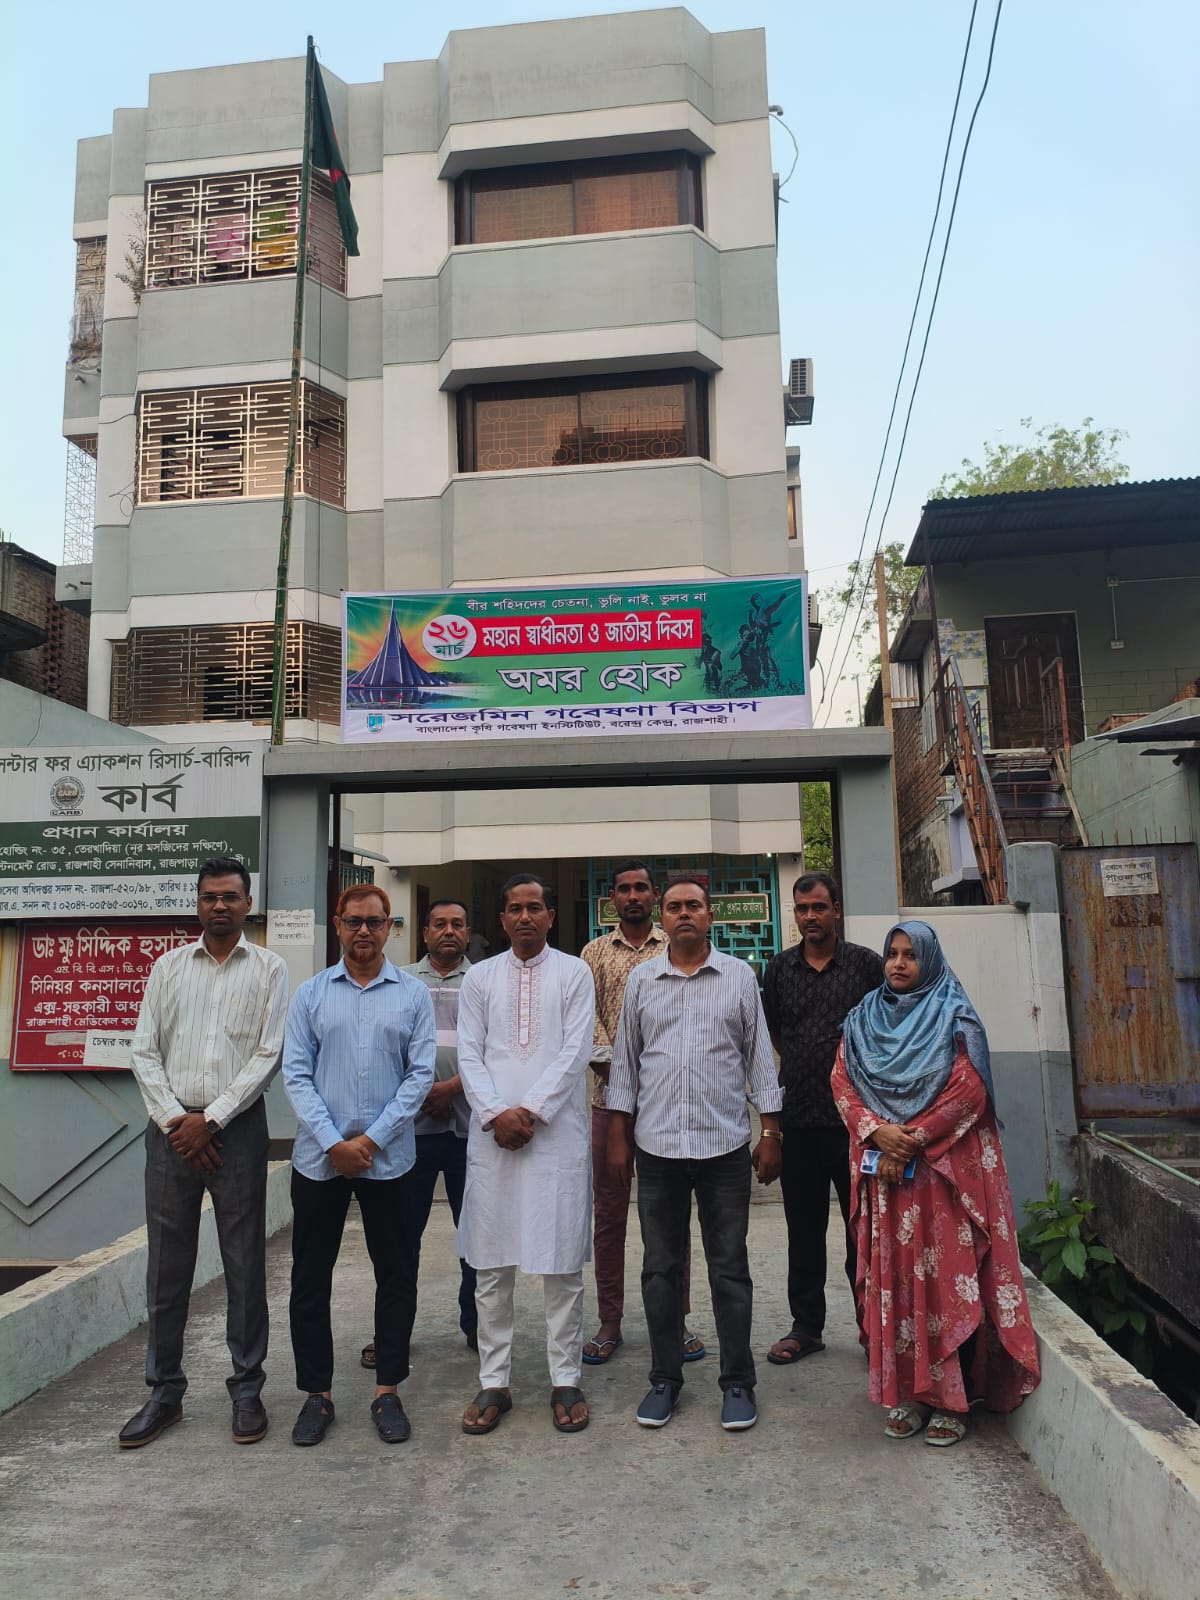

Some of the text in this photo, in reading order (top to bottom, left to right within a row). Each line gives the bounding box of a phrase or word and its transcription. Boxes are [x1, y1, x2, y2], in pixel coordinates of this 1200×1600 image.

[466, 592, 707, 611] বীর শহিদদের চেতনা, ভুলি নাই, ভুলব না
[428, 621, 468, 642] ২৬
[482, 612, 693, 648] মহান স্বাধীনতা ও জাতীয় দিবস
[433, 641, 465, 656] মার্চ
[496, 660, 686, 693] অমর হোক
[390, 701, 763, 724] সরেজমিন গবেষণা বিভাগ
[416, 726, 467, 734] বাংলাদেশ
[472, 723, 493, 734] কৃষি
[497, 723, 537, 732] গবেষণা
[542, 721, 605, 729] ইনস্টিটিউট,
[647, 719, 677, 727] কেন্দ্র,
[44, 756, 72, 772] ফর
[77, 752, 143, 771] এ্যাকশন
[148, 746, 252, 769] রিসার্চ-বারিন্দ
[97, 773, 185, 813] কার্ব
[43, 821, 189, 839] প্রধান কার্যালয়
[31, 847, 47, 855] নং-
[125, 843, 143, 856] (নূর
[146, 840, 188, 853] মসজিদের
[65, 857, 101, 870] রাজশাহী
[55, 885, 72, 894] সনদ
[158, 880, 181, 892] তারিখ
[23, 902, 38, 910] সনদ
[155, 896, 178, 909] তারিখ
[727, 903, 741, 915] প্রধান
[742, 898, 763, 913] কার্যালয়
[32, 934, 54, 958] ডাঃ
[76, 927, 133, 958] সিদ্দিক
[30, 975, 74, 994] সিনিয়র
[26, 1015, 72, 1027] রাজশাহী
[74, 1014, 118, 1026] মেডিকেল
[93, 1037, 117, 1046] চেম্বার
